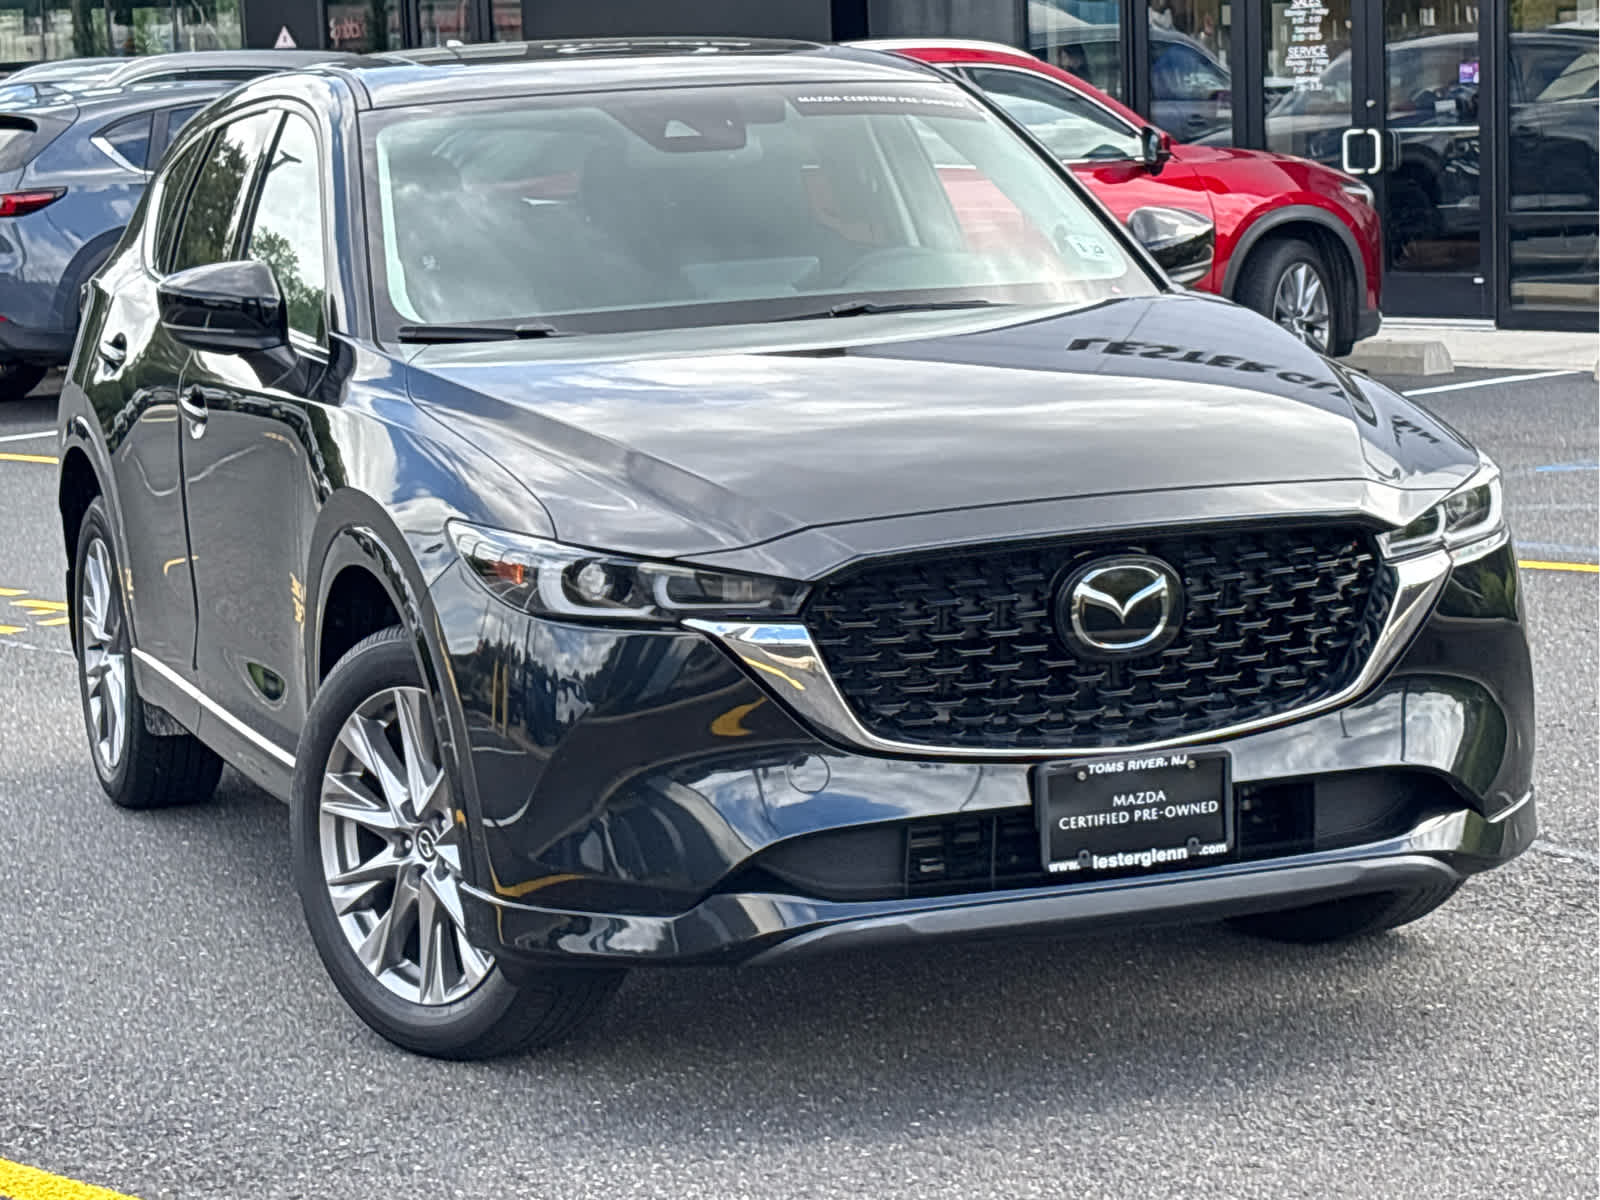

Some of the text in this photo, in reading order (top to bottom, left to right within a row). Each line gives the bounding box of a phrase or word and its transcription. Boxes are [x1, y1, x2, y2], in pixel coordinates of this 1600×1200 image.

[1288, 46, 1327, 56] SERVICE
[1087, 761, 1125, 775] TOMS
[1170, 754, 1188, 766] NJ
[1112, 790, 1166, 807] MAZDA
[1058, 800, 1219, 831] CERTIFIED PRE-OWNED
